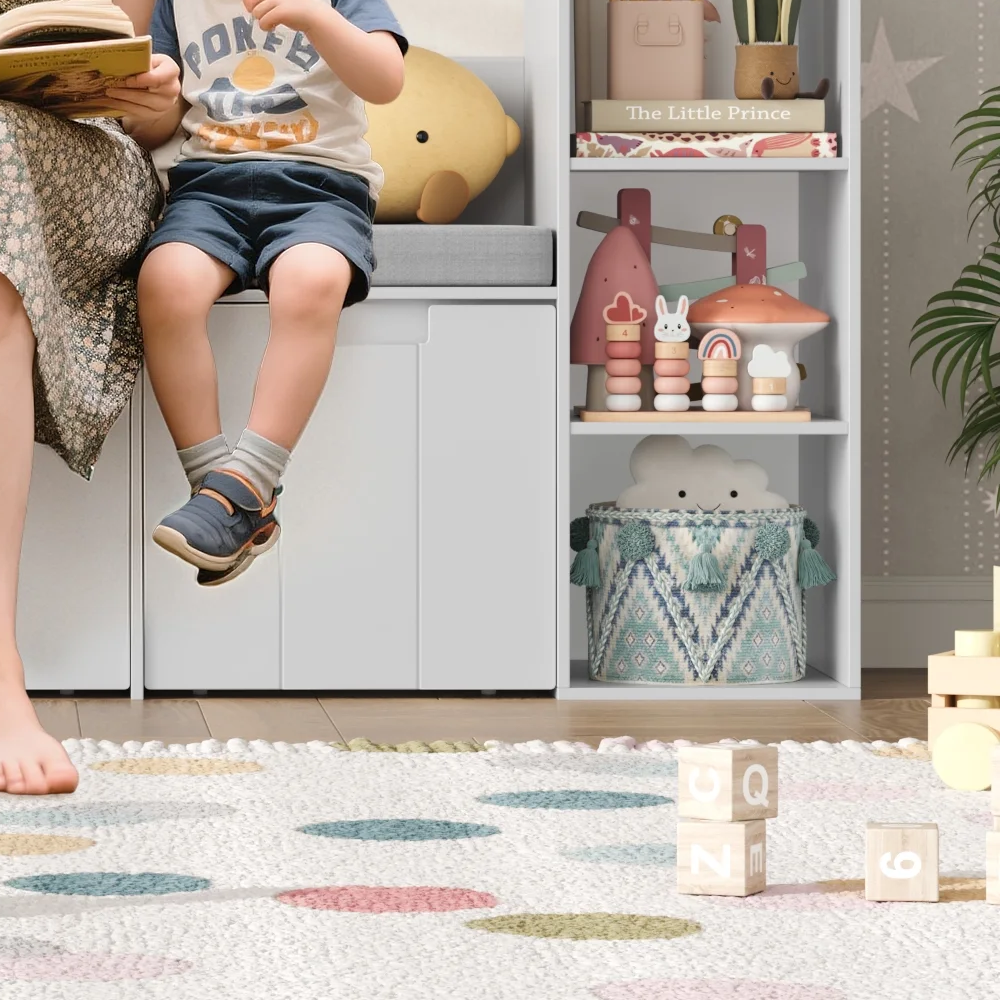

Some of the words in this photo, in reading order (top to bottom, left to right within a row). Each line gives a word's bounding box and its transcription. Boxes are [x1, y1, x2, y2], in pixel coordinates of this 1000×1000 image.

[625, 105, 662, 121] The
[667, 105, 722, 121] Little
[727, 105, 791, 121] Prince
[621, 329, 629, 337] 4
[671, 347, 678, 355] 3
[687, 766, 721, 801] C
[742, 763, 770, 808] Q
[749, 843, 763, 877] E
